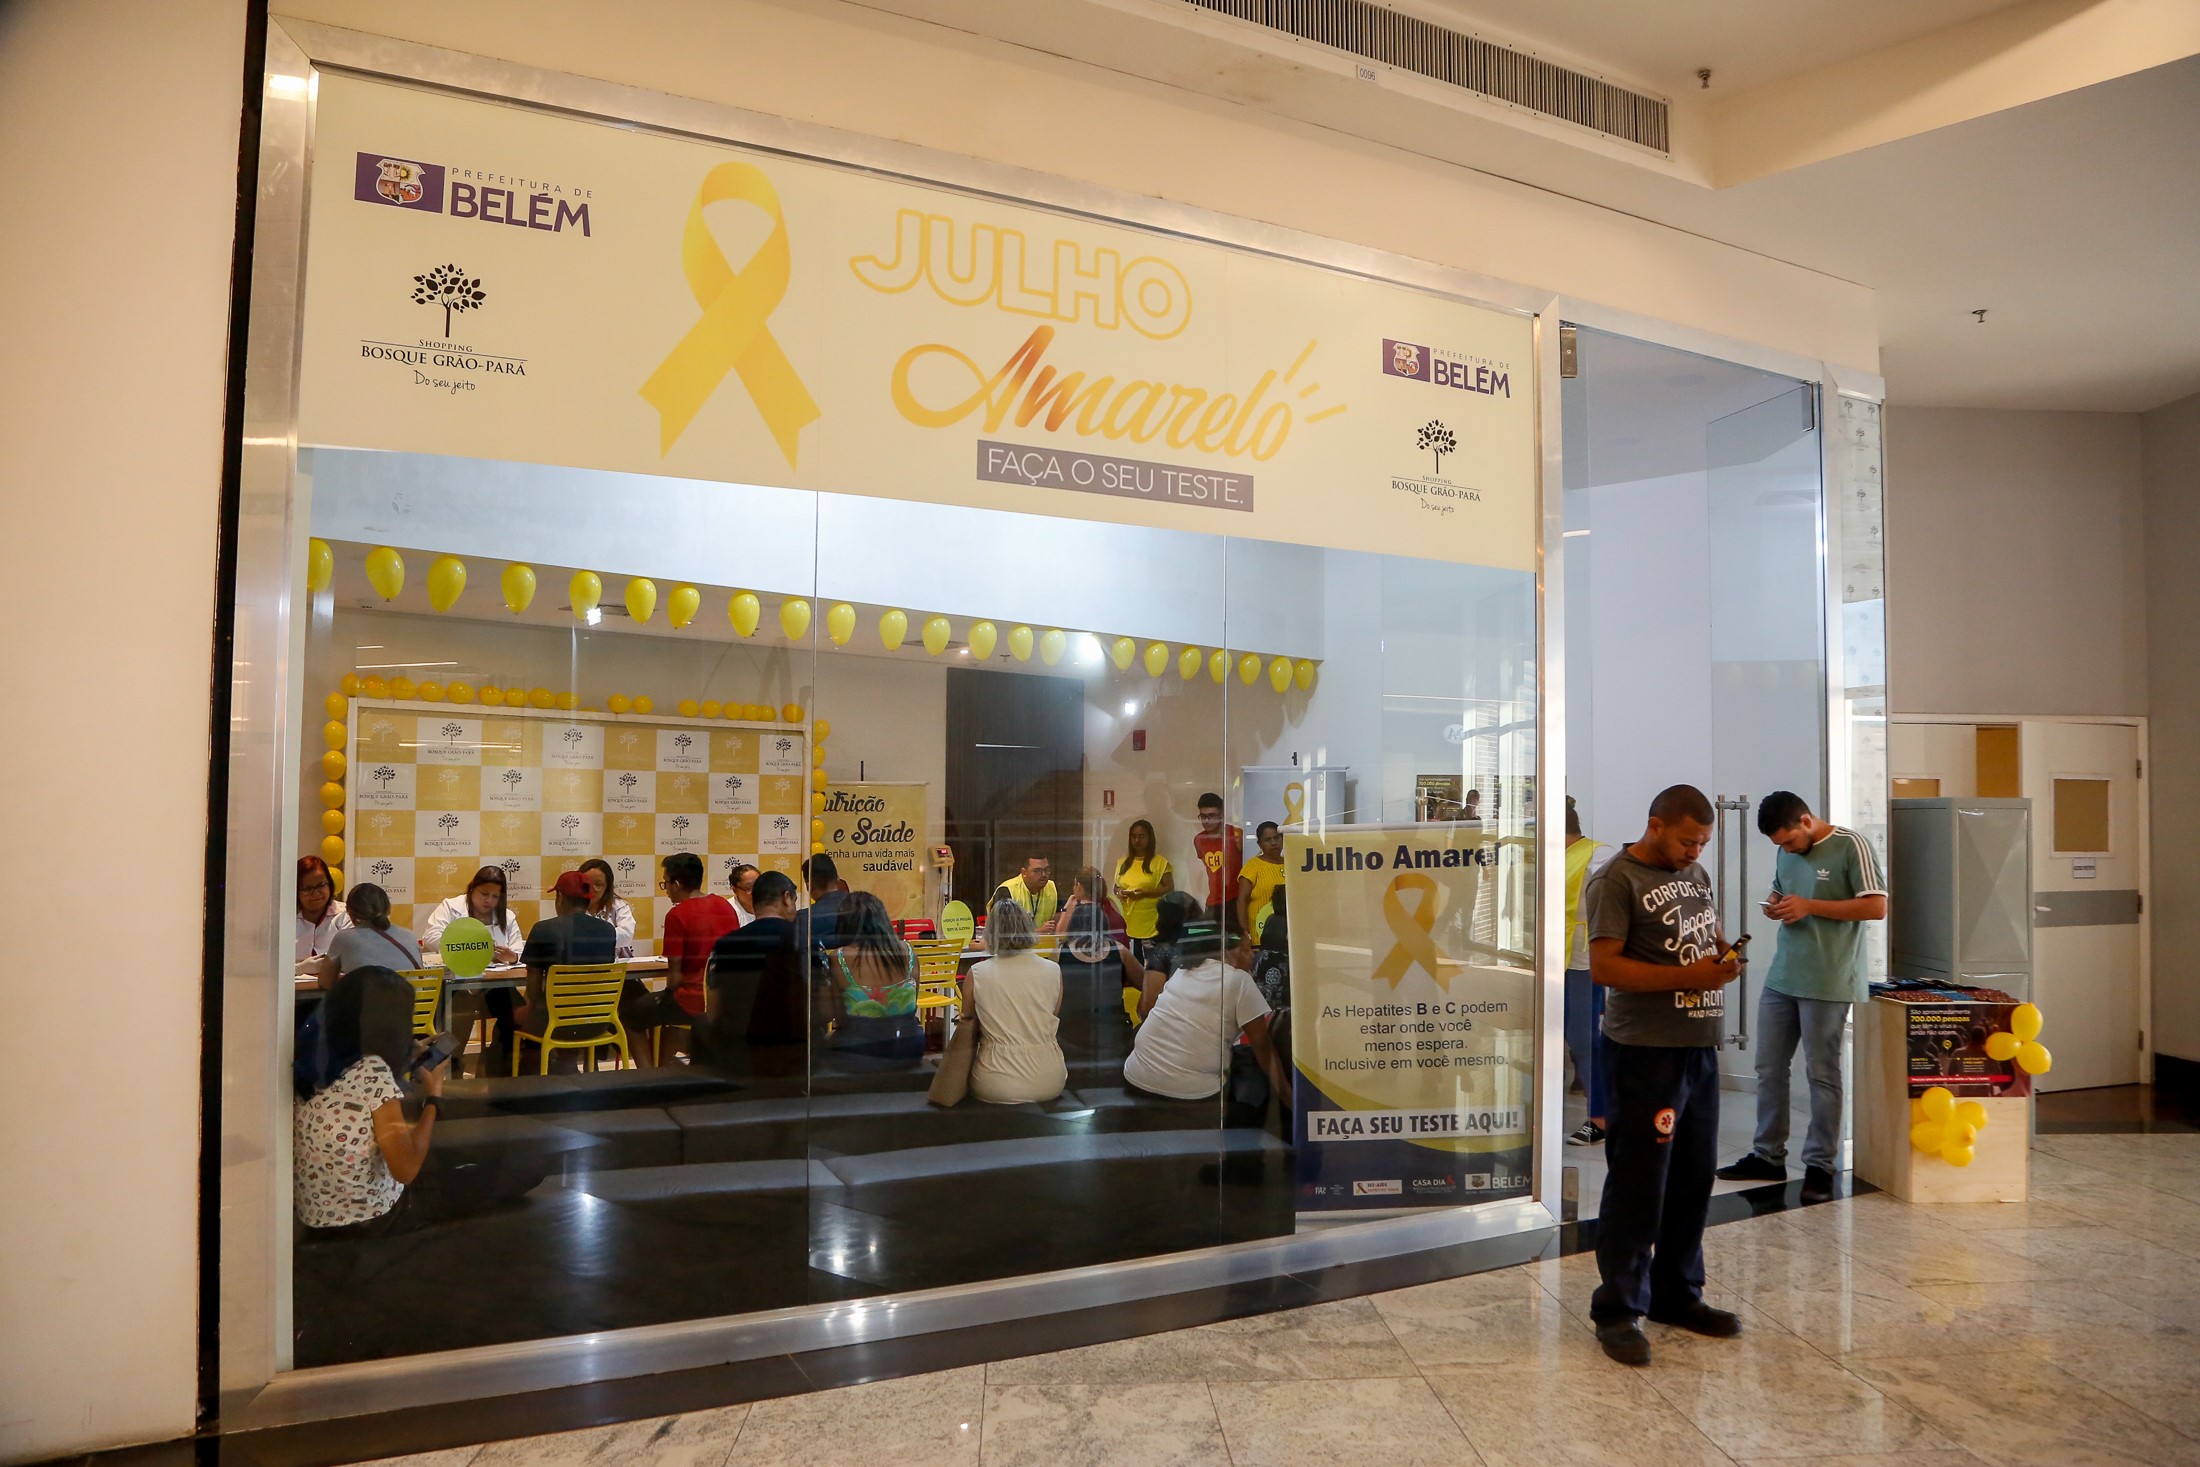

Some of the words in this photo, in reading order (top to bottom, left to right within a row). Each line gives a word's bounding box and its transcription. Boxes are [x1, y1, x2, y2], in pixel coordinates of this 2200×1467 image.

[1360, 68, 1376, 81] 0096
[452, 168, 562, 193] PREFEITURA
[574, 188, 592, 198] DE
[450, 182, 591, 237] BELÉM
[849, 208, 1192, 340] JULHO
[419, 339, 473, 352] SHOPPING
[361, 346, 427, 366] BOSQUE
[433, 353, 526, 376] GRÃO-PARÁ
[1434, 348, 1493, 366] PREFEITURA
[1500, 362, 1510, 370] DE
[414, 370, 430, 385] Do
[433, 378, 450, 388] seu
[451, 379, 475, 394] jeito
[1434, 358, 1510, 398] BELÉM
[891, 324, 1293, 462] Amarelo
[988, 448, 1063, 485] FAÇA
[1071, 460, 1095, 486] O
[1102, 463, 1154, 492] SEU
[1161, 471, 1244, 504] TESTE.
[1423, 475, 1452, 484] SHOPPING
[1392, 480, 1428, 494] BOSQUE
[1430, 486, 1481, 502] GRÃO-PARÁ
[821, 791, 884, 815] utrição
[834, 829, 845, 843] e
[851, 818, 915, 845] Saúde
[875, 848, 892, 857] vida
[895, 848, 914, 857] mais
[1301, 847, 1384, 872] Julho
[1392, 843, 1518, 869] Amarel
[446, 942, 488, 952] TESTAGEM
[1323, 1005, 1340, 1018] As
[1346, 1004, 1412, 1019] Hepatites
[1416, 1003, 1427, 1015] B
[1432, 1005, 1440, 1014] e
[1445, 1002, 1456, 1014] C
[1461, 1001, 1508, 1017] podem
[1360, 1023, 1395, 1034] estar
[1400, 1020, 1435, 1033] onde
[1439, 1019, 1472, 1032] você
[1365, 1042, 1412, 1052] menos
[1416, 1039, 1468, 1053] espera.
[1325, 1057, 1386, 1071] Inclusive
[1391, 1059, 1412, 1069] em
[1416, 1055, 1449, 1068] você
[1454, 1055, 1509, 1066] mesmo.
[1317, 1117, 1364, 1139] FAÇA
[1370, 1116, 1402, 1134] SEU
[1410, 1114, 1459, 1132] TESTE
[1465, 1111, 1519, 1133] AQUI!
